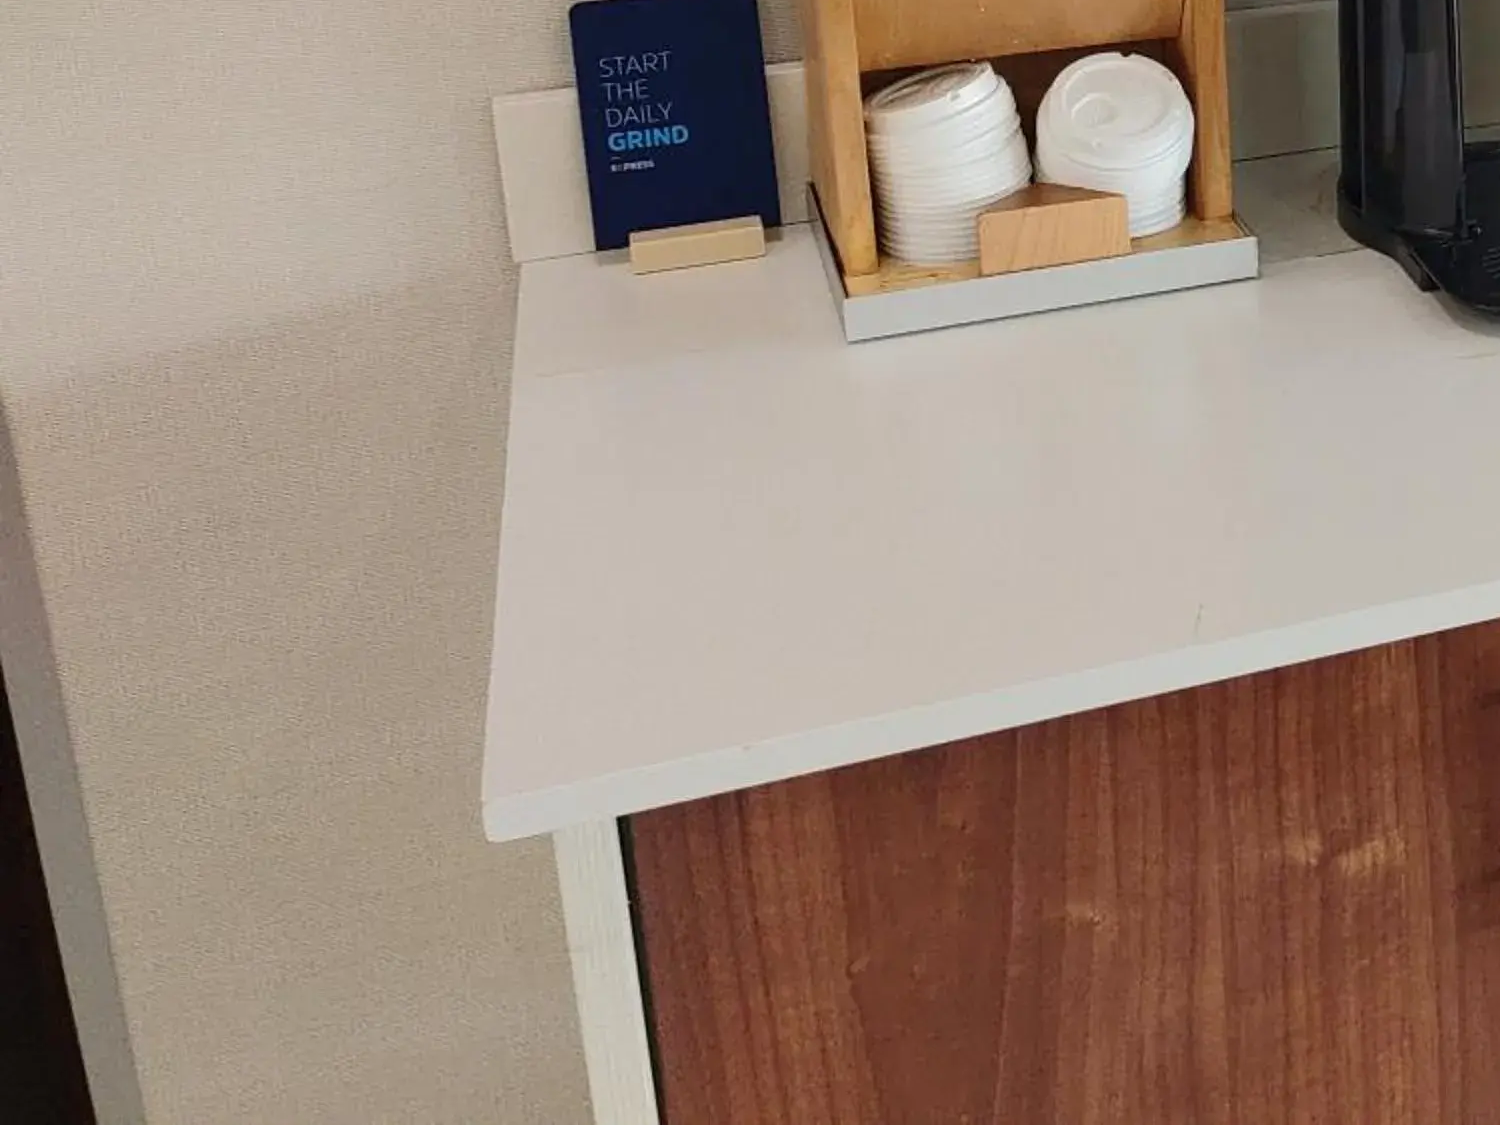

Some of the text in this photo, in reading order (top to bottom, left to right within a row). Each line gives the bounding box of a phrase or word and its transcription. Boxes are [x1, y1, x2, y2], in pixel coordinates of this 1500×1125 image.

[599, 50, 673, 78] START
[602, 78, 650, 103] THE
[604, 101, 673, 128] DAILY
[607, 125, 690, 152] GRIND
